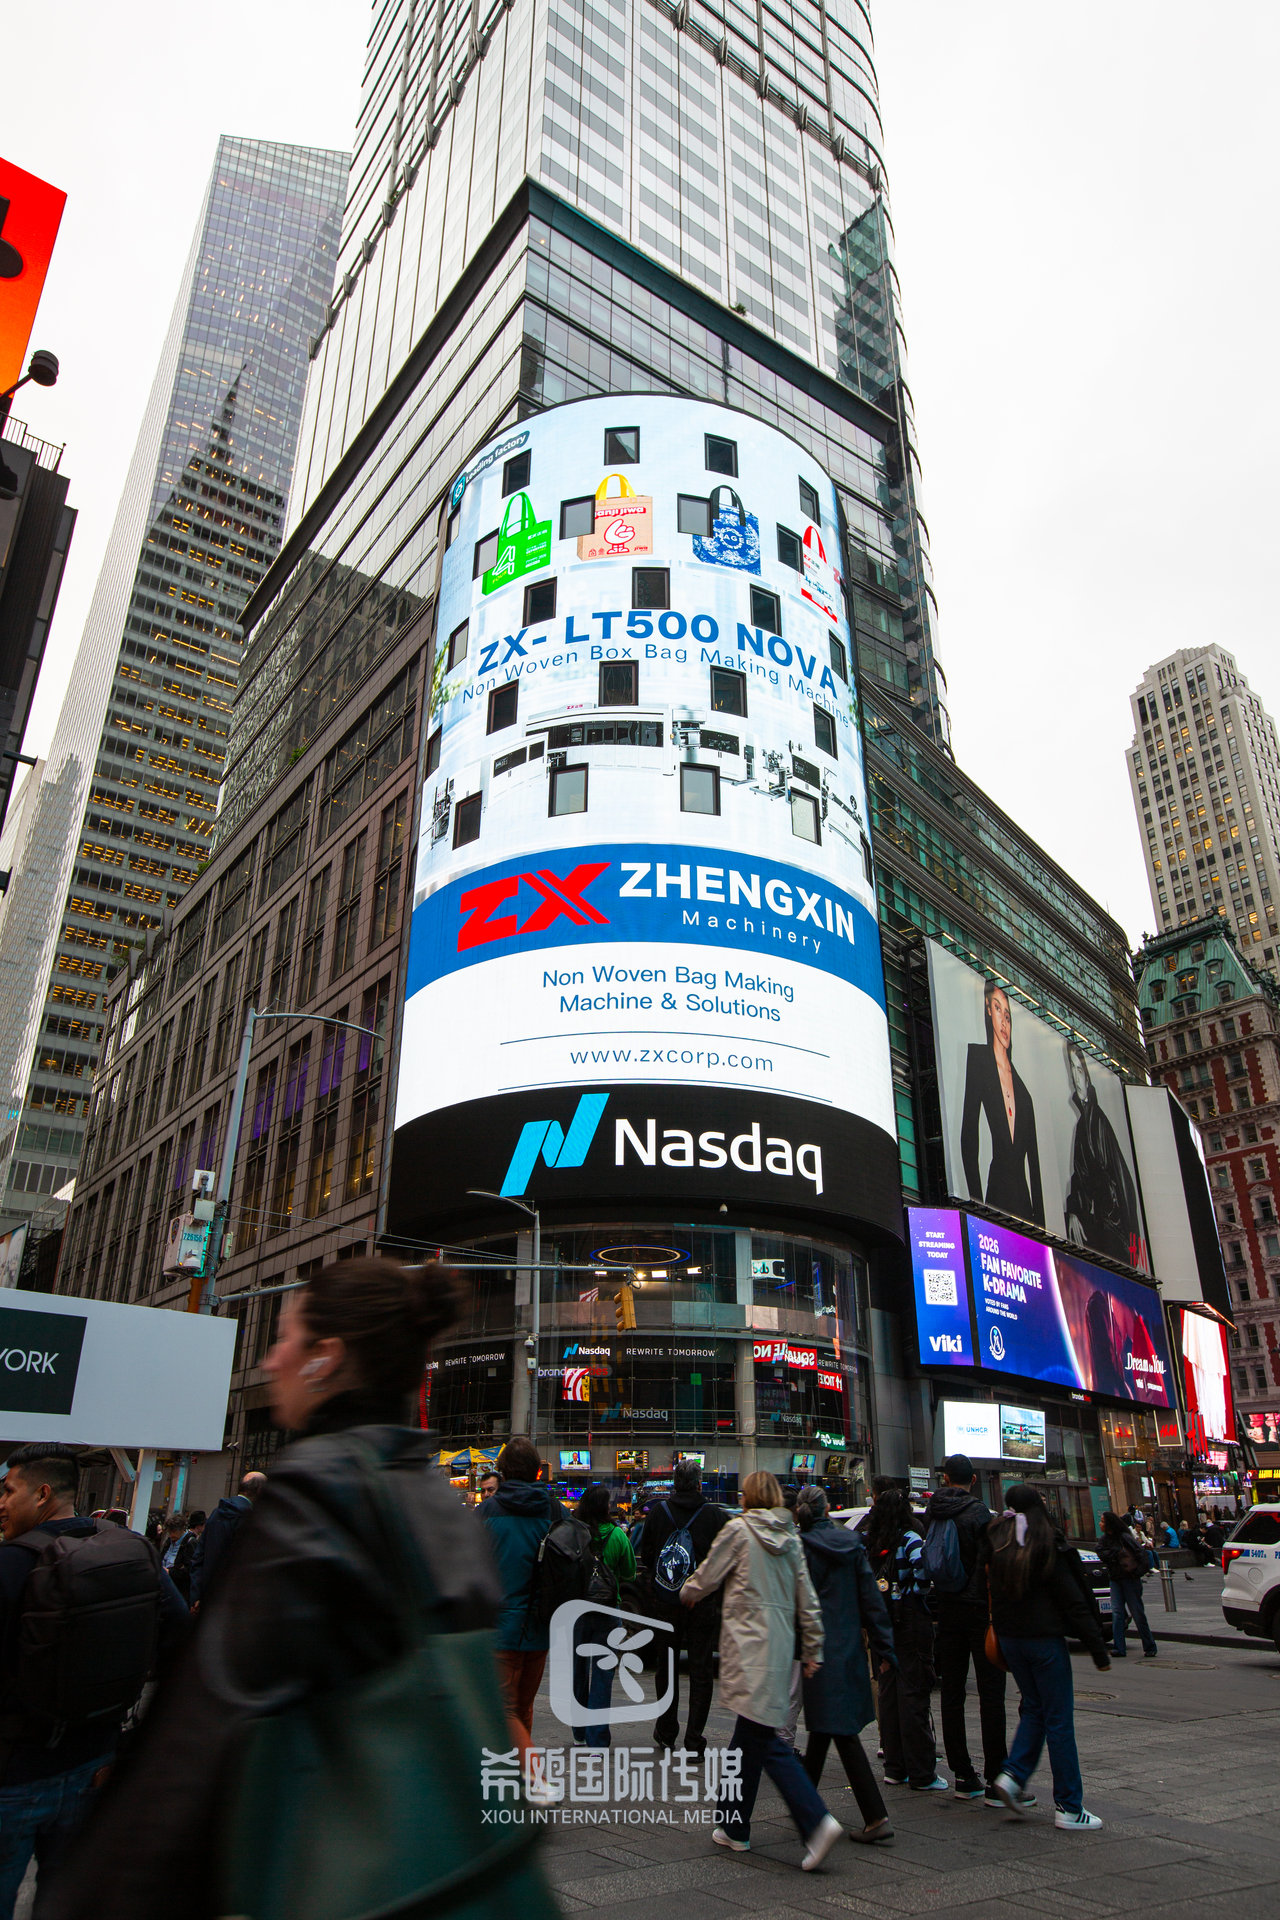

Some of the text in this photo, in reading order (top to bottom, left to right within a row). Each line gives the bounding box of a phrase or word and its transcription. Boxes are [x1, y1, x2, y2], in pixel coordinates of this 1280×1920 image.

[465, 434, 526, 483] Leading factory
[478, 610, 838, 699] ZX- LT500 NOVA
[463, 644, 849, 728] Non Woven Box Bag Making Machine
[456, 862, 856, 953] ZX ZHENGXIN
[683, 909, 822, 954] Machinery
[543, 965, 794, 1003] Non Woven Bag Making
[560, 992, 781, 1022] Machine & Solutions
[570, 1048, 774, 1073] www.zxcorp.com
[615, 1118, 824, 1196] Nasdaq
[919, 1241, 956, 1249] STREAMING
[927, 1251, 949, 1259] TODAY
[978, 1234, 1000, 1255] 2026
[981, 1252, 1042, 1290] FAN FAVORITE
[982, 1273, 1027, 1304] K-DRAMA
[445, 1353, 505, 1366] REWRITE TOMORROW
[579, 1346, 611, 1356] Nasdaq
[626, 1348, 716, 1357] REWRITE TOMORROW
[1125, 1352, 1148, 1372] Dream
[1152, 1354, 1167, 1374] You
[623, 1408, 668, 1421] Nasdaq
